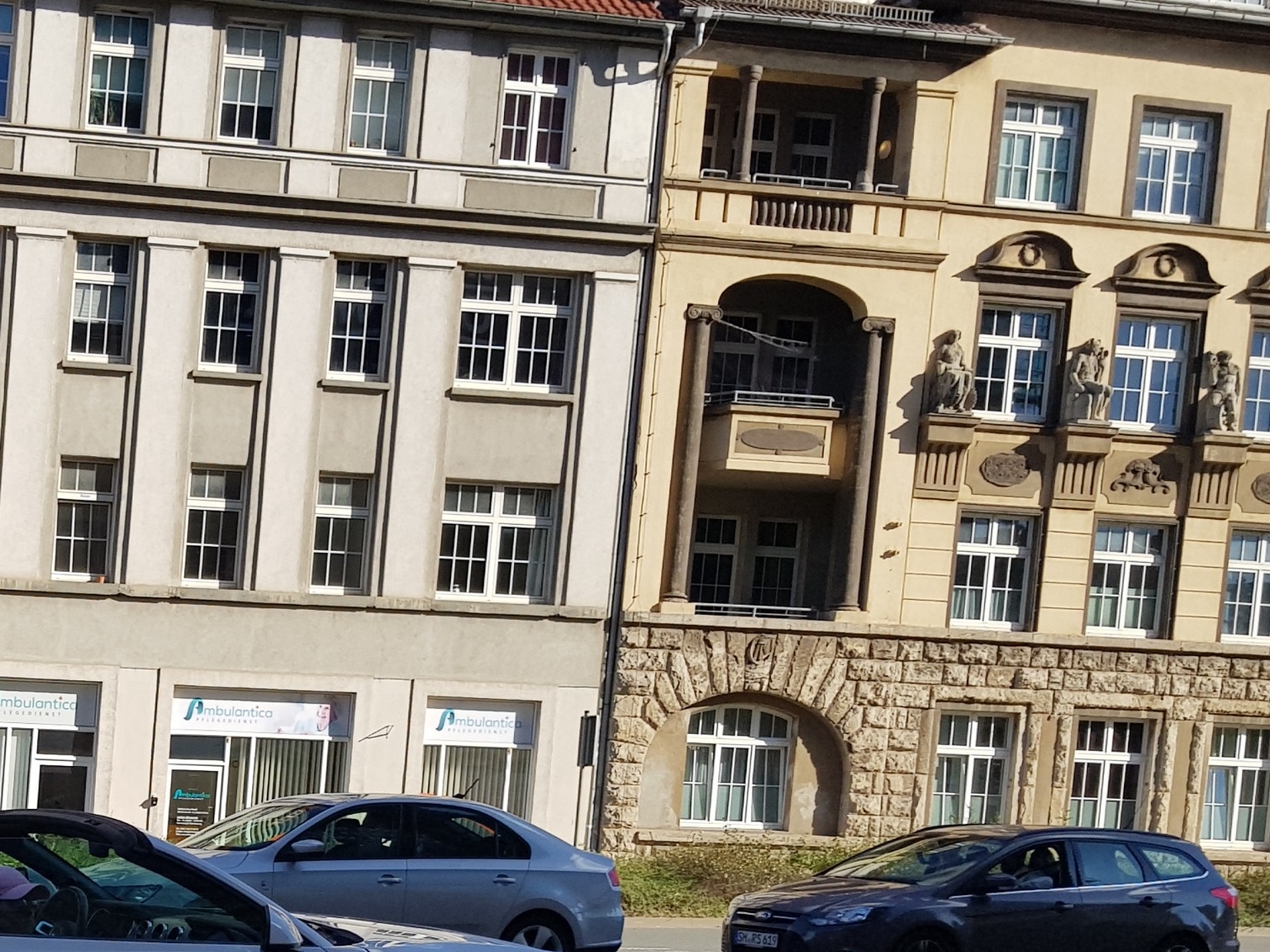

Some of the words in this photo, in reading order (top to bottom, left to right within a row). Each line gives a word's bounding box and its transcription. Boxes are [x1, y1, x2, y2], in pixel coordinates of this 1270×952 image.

[183, 697, 273, 721] Ambulantica
[435, 707, 523, 731] Ambulantica
[762, 934, 777, 946] 619
